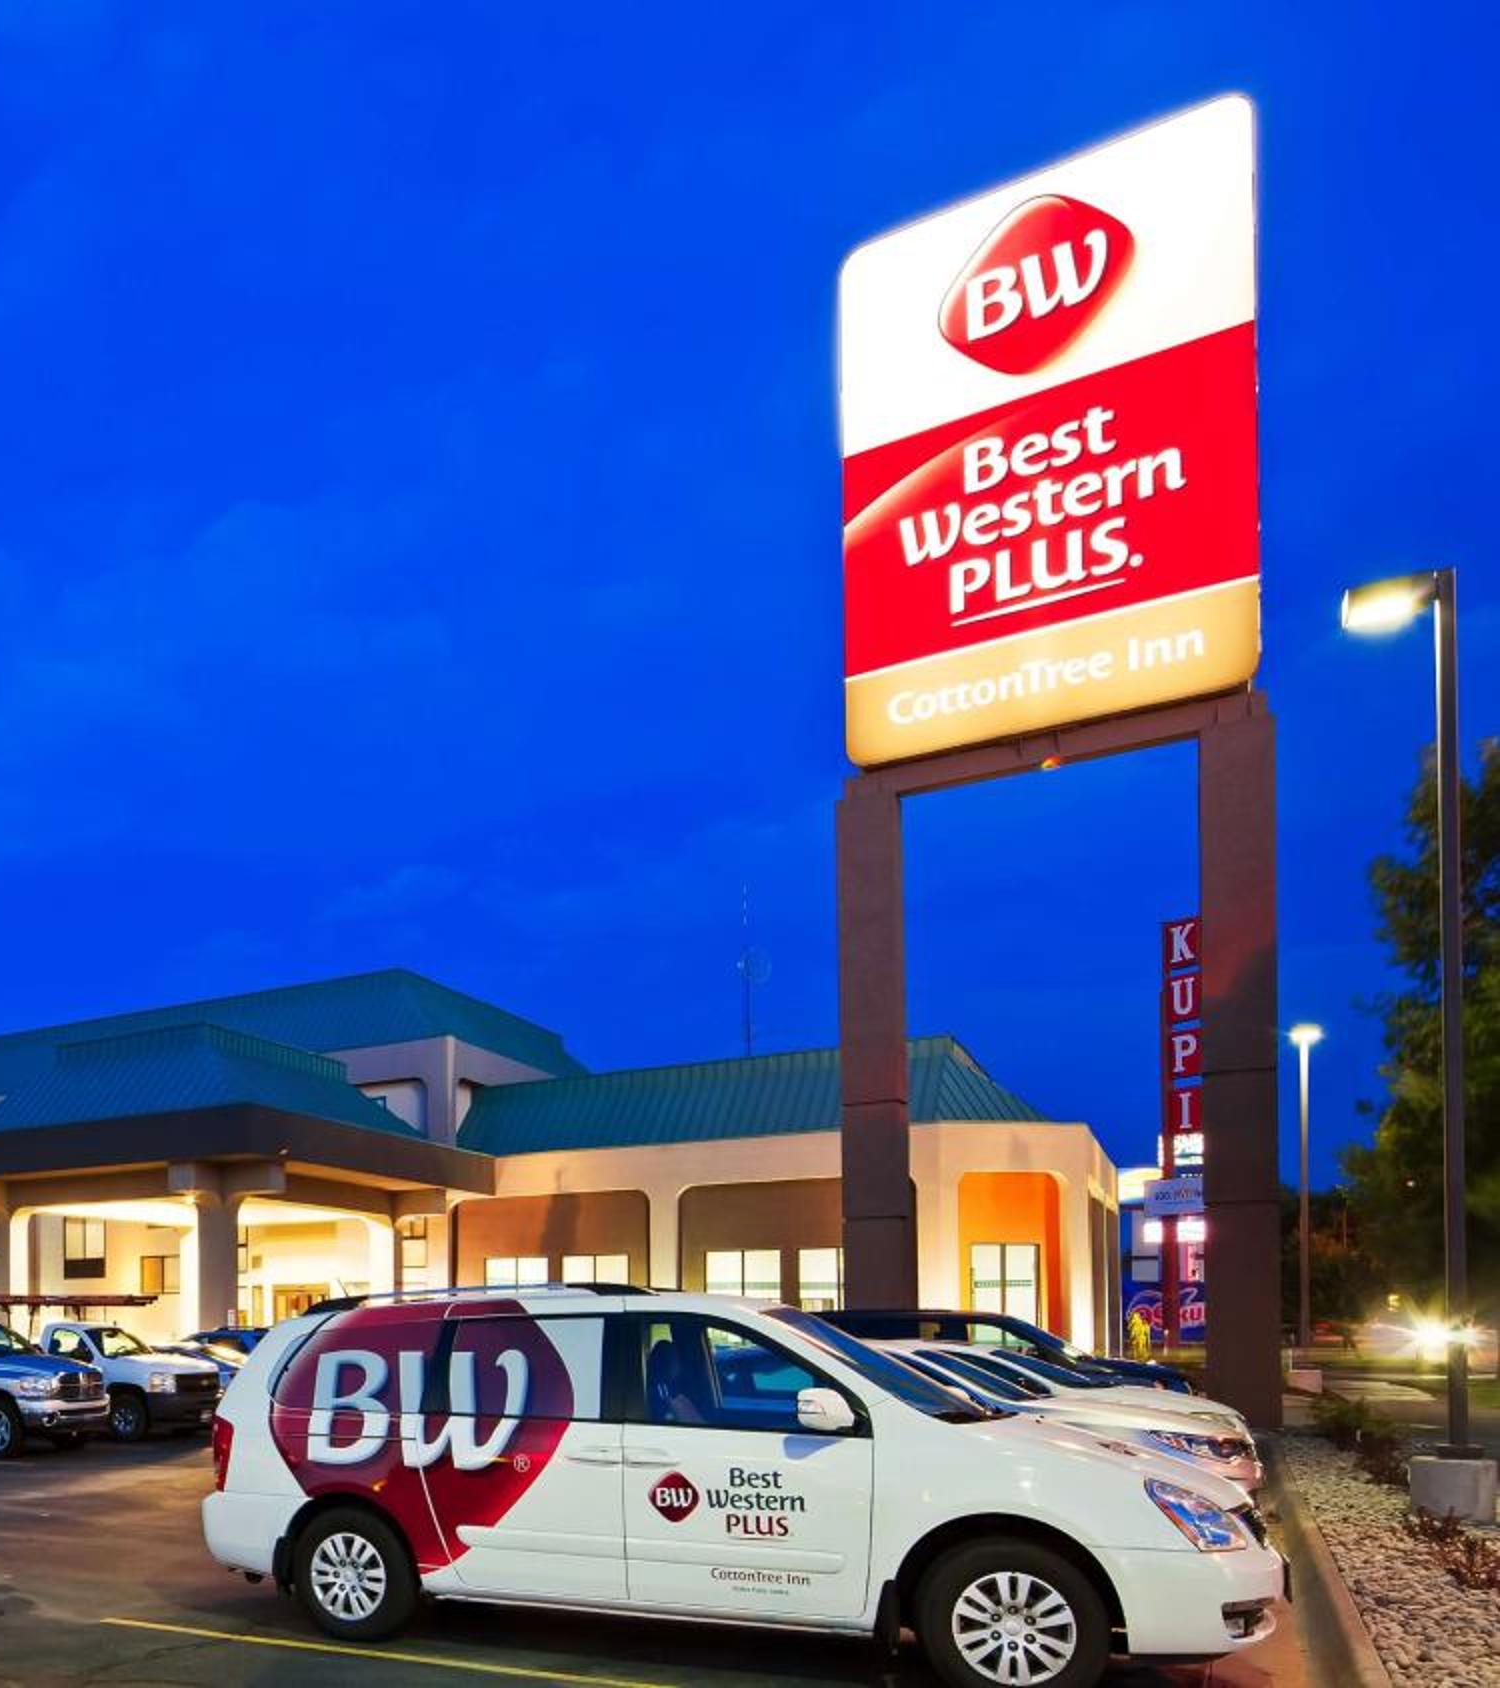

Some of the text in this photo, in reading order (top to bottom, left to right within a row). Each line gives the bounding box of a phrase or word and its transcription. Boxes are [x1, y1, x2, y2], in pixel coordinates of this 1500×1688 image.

[965, 227, 1107, 342] BW
[962, 405, 1117, 494] Best
[898, 446, 1186, 566] Western
[886, 628, 1205, 726] CottonTree Inn
[307, 1349, 529, 1471] BW
[656, 1487, 693, 1507] BW
[705, 1489, 806, 1513] Western
[729, 1467, 783, 1489] Best
[710, 1567, 812, 1586] CottonTree Inn
